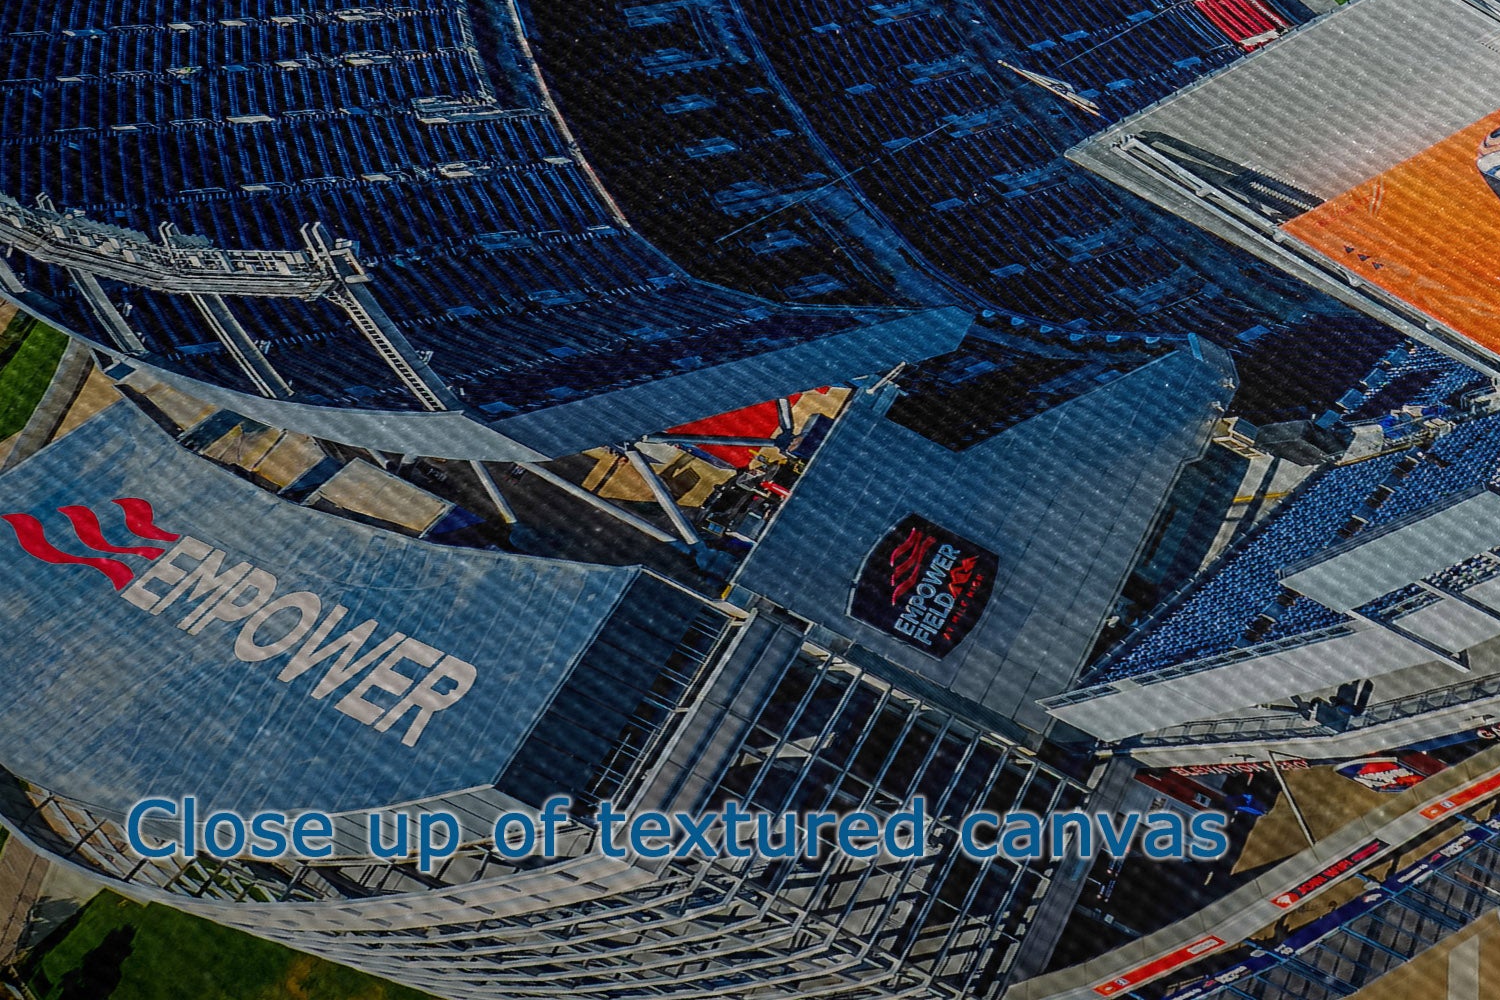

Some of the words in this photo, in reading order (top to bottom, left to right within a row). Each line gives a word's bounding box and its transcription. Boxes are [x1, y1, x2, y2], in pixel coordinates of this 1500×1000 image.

[894, 544, 961, 636] EMPOWER
[913, 592, 955, 646] FIELD
[120, 535, 478, 748] EMPOWER
[1170, 761, 1267, 777] ELEVATION
